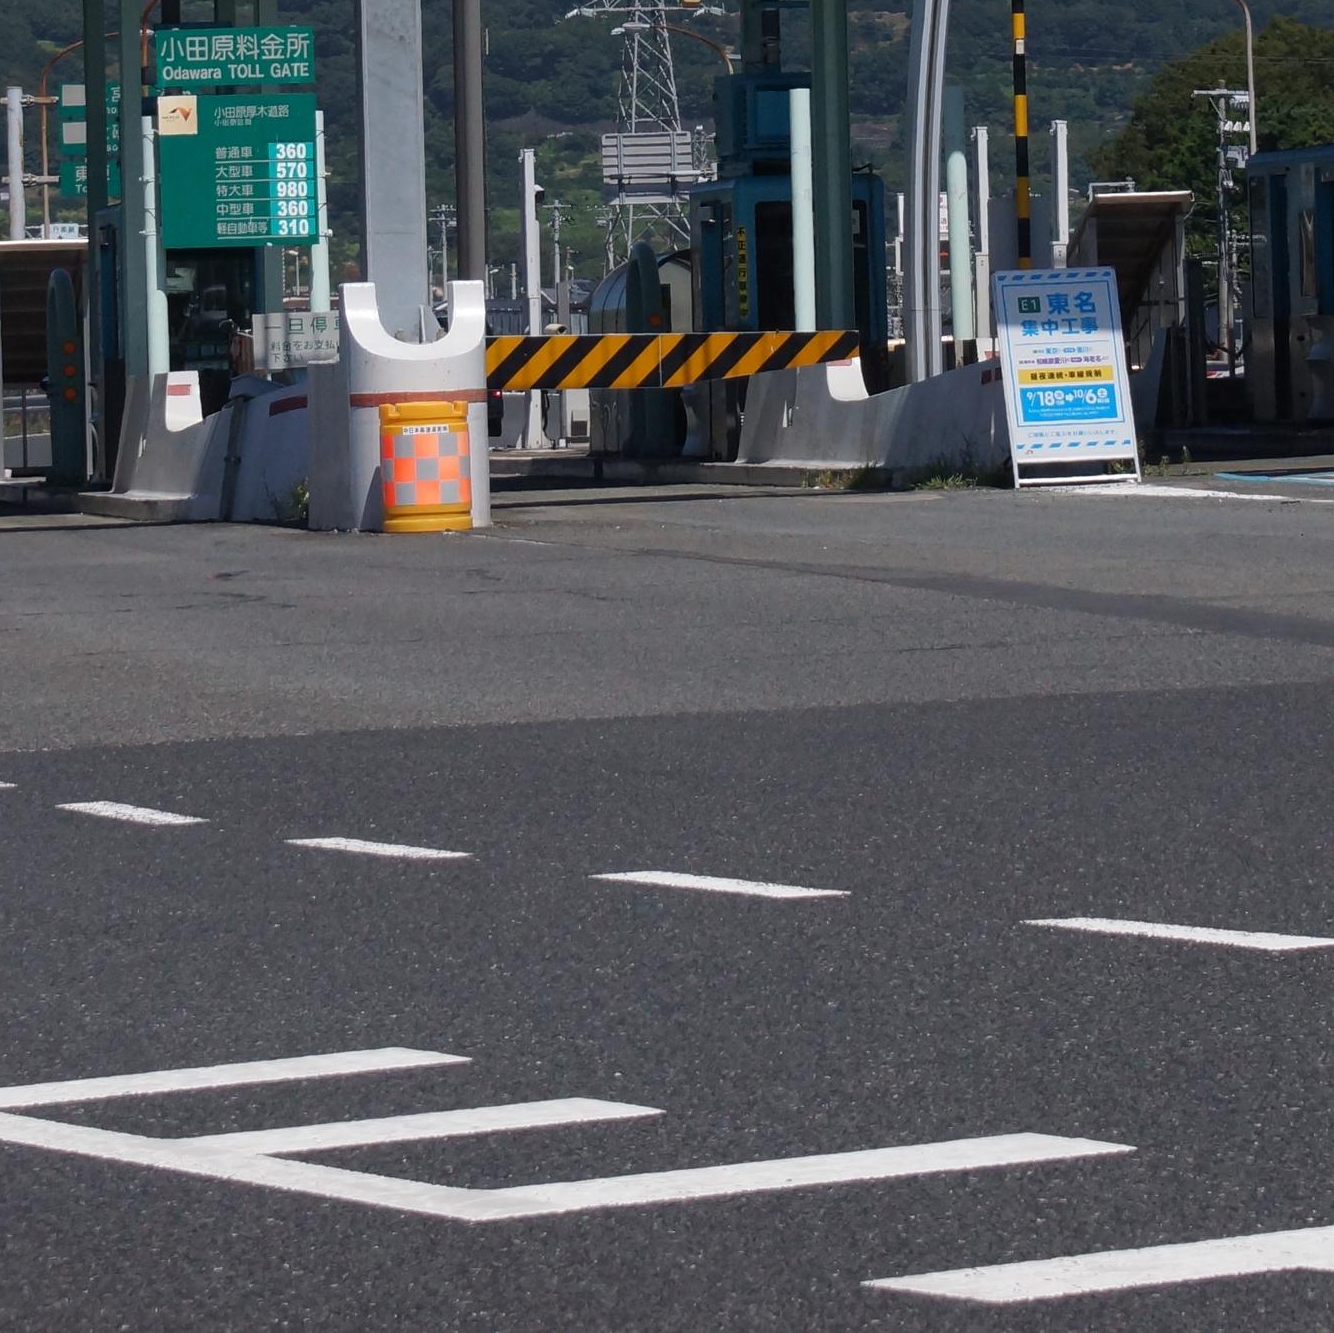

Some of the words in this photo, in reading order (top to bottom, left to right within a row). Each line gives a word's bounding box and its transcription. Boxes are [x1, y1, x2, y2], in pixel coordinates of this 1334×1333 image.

[161, 33, 310, 61] 小田原料金所
[163, 67, 222, 80] Odawara
[228, 64, 264, 79] TOLL
[270, 62, 309, 77] GATE
[214, 105, 289, 118] 小田原厚木道路
[215, 146, 253, 159] 普通車
[276, 143, 306, 159] 360
[216, 165, 253, 178] 大型車
[277, 162, 307, 178] 570
[216, 183, 254, 196] 特大車
[277, 181, 308, 197] 980
[217, 203, 254, 216] 中型車
[278, 201, 308, 216] 360
[279, 219, 309, 235] 310
[1021, 299, 1038, 313] E1
[1046, 291, 1096, 315] 東名
[265, 317, 339, 335] 一旦停
[1020, 317, 1099, 336] 集中工事
